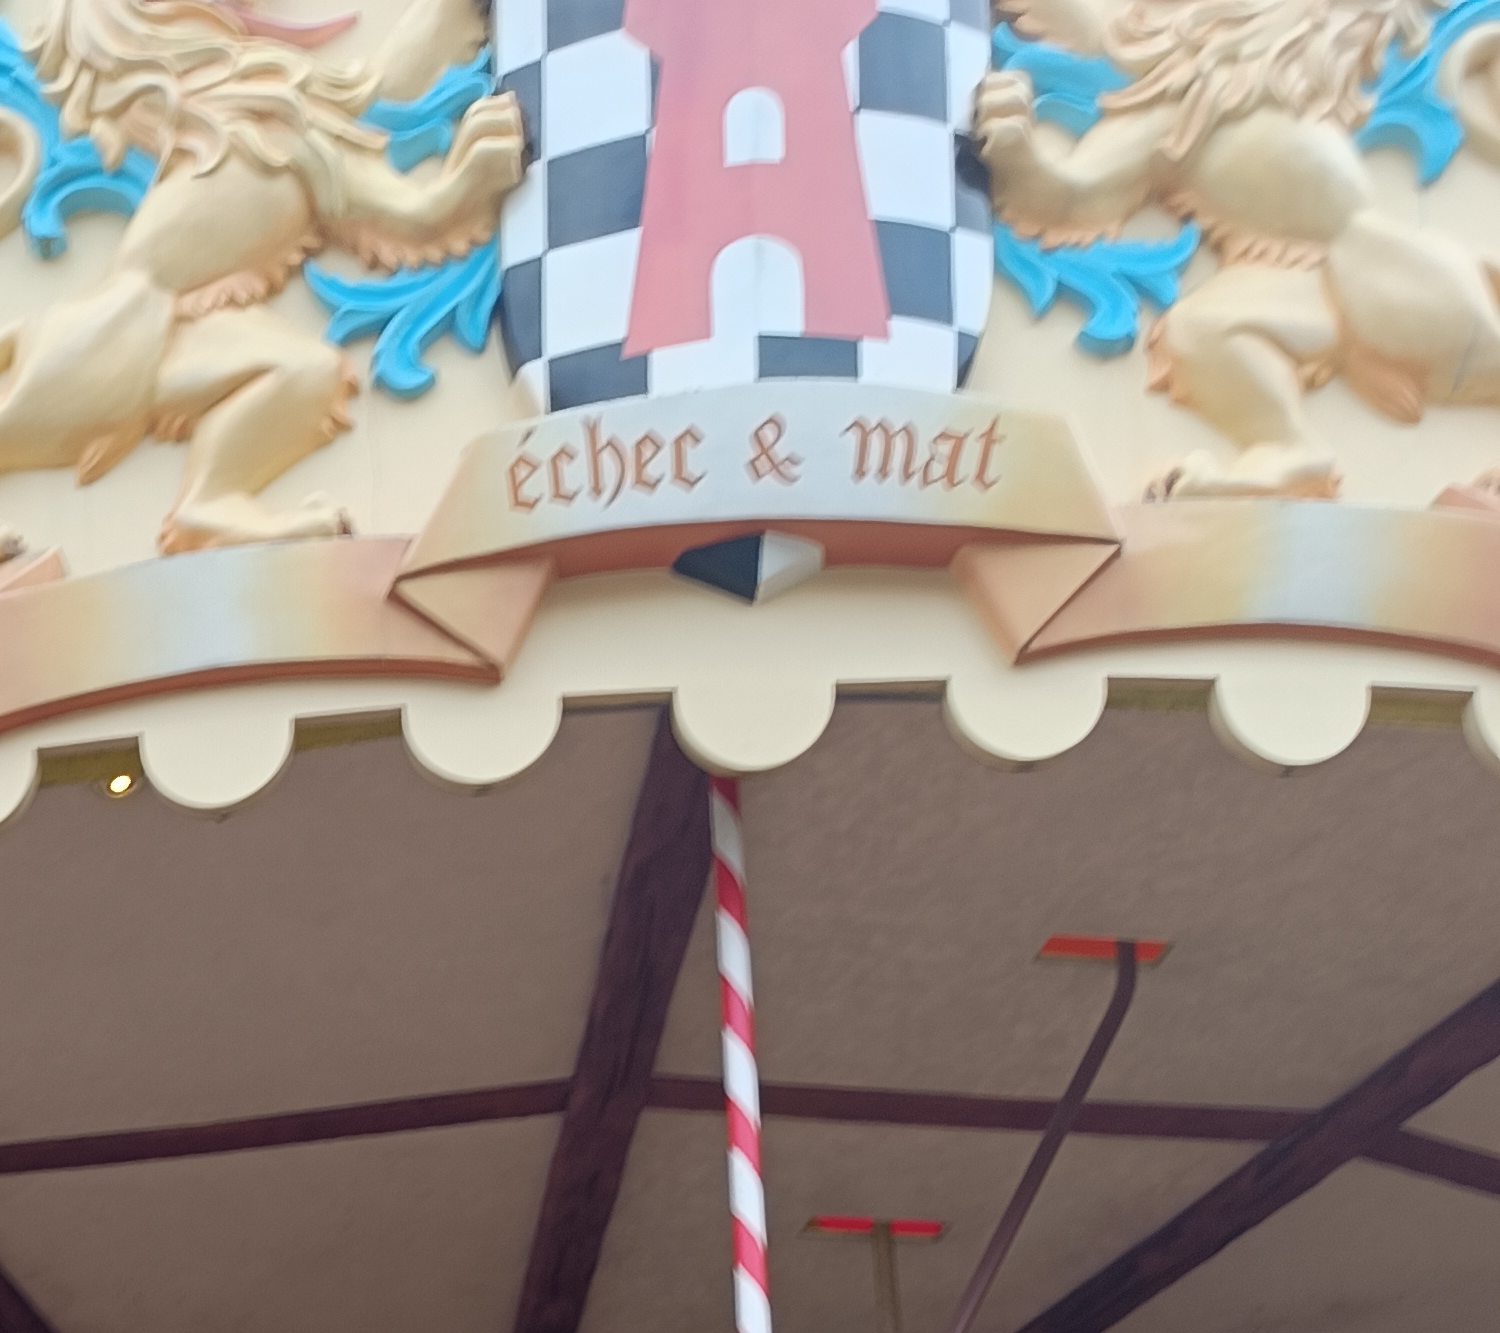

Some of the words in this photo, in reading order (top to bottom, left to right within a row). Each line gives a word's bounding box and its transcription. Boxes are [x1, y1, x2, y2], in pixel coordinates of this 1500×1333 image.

[507, 412, 708, 512] échec
[745, 411, 804, 485] &
[838, 412, 1007, 492] mat
